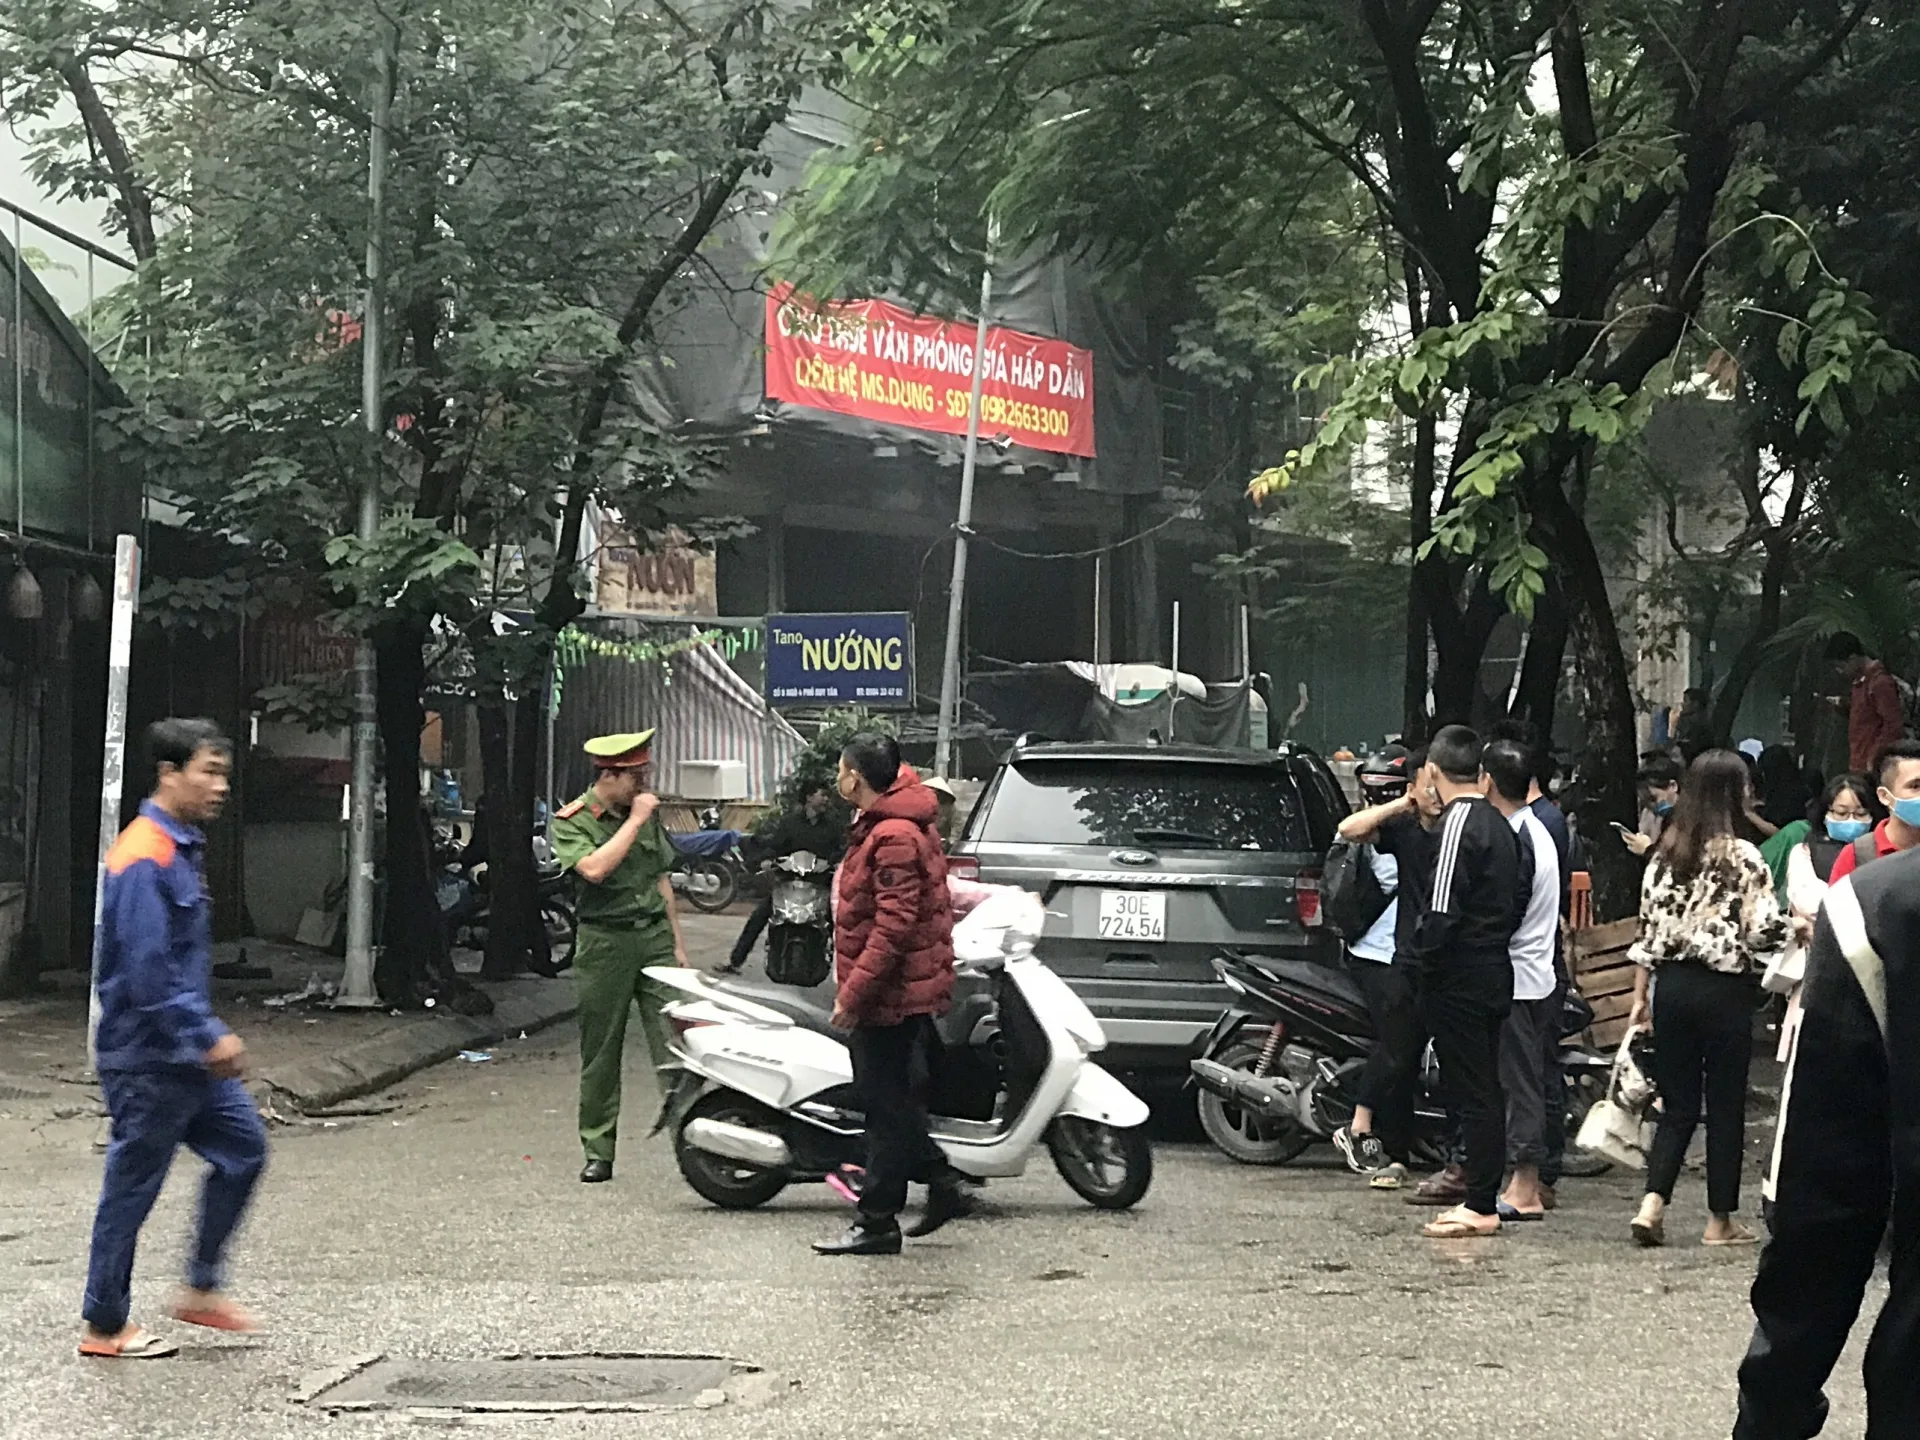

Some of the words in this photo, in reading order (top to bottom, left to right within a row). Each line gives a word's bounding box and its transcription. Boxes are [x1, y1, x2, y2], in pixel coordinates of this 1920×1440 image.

[873, 320, 909, 364] VĂN
[914, 331, 973, 376] PHÒNG
[1011, 346, 1044, 391] HẤP
[796, 352, 835, 394] LIÊN
[838, 361, 858, 403] HỆ
[773, 629, 803, 645] Tano
[802, 629, 902, 671] NƯỚNG
[1116, 895, 1150, 915] 30E
[1101, 916, 1161, 938] 724.54
